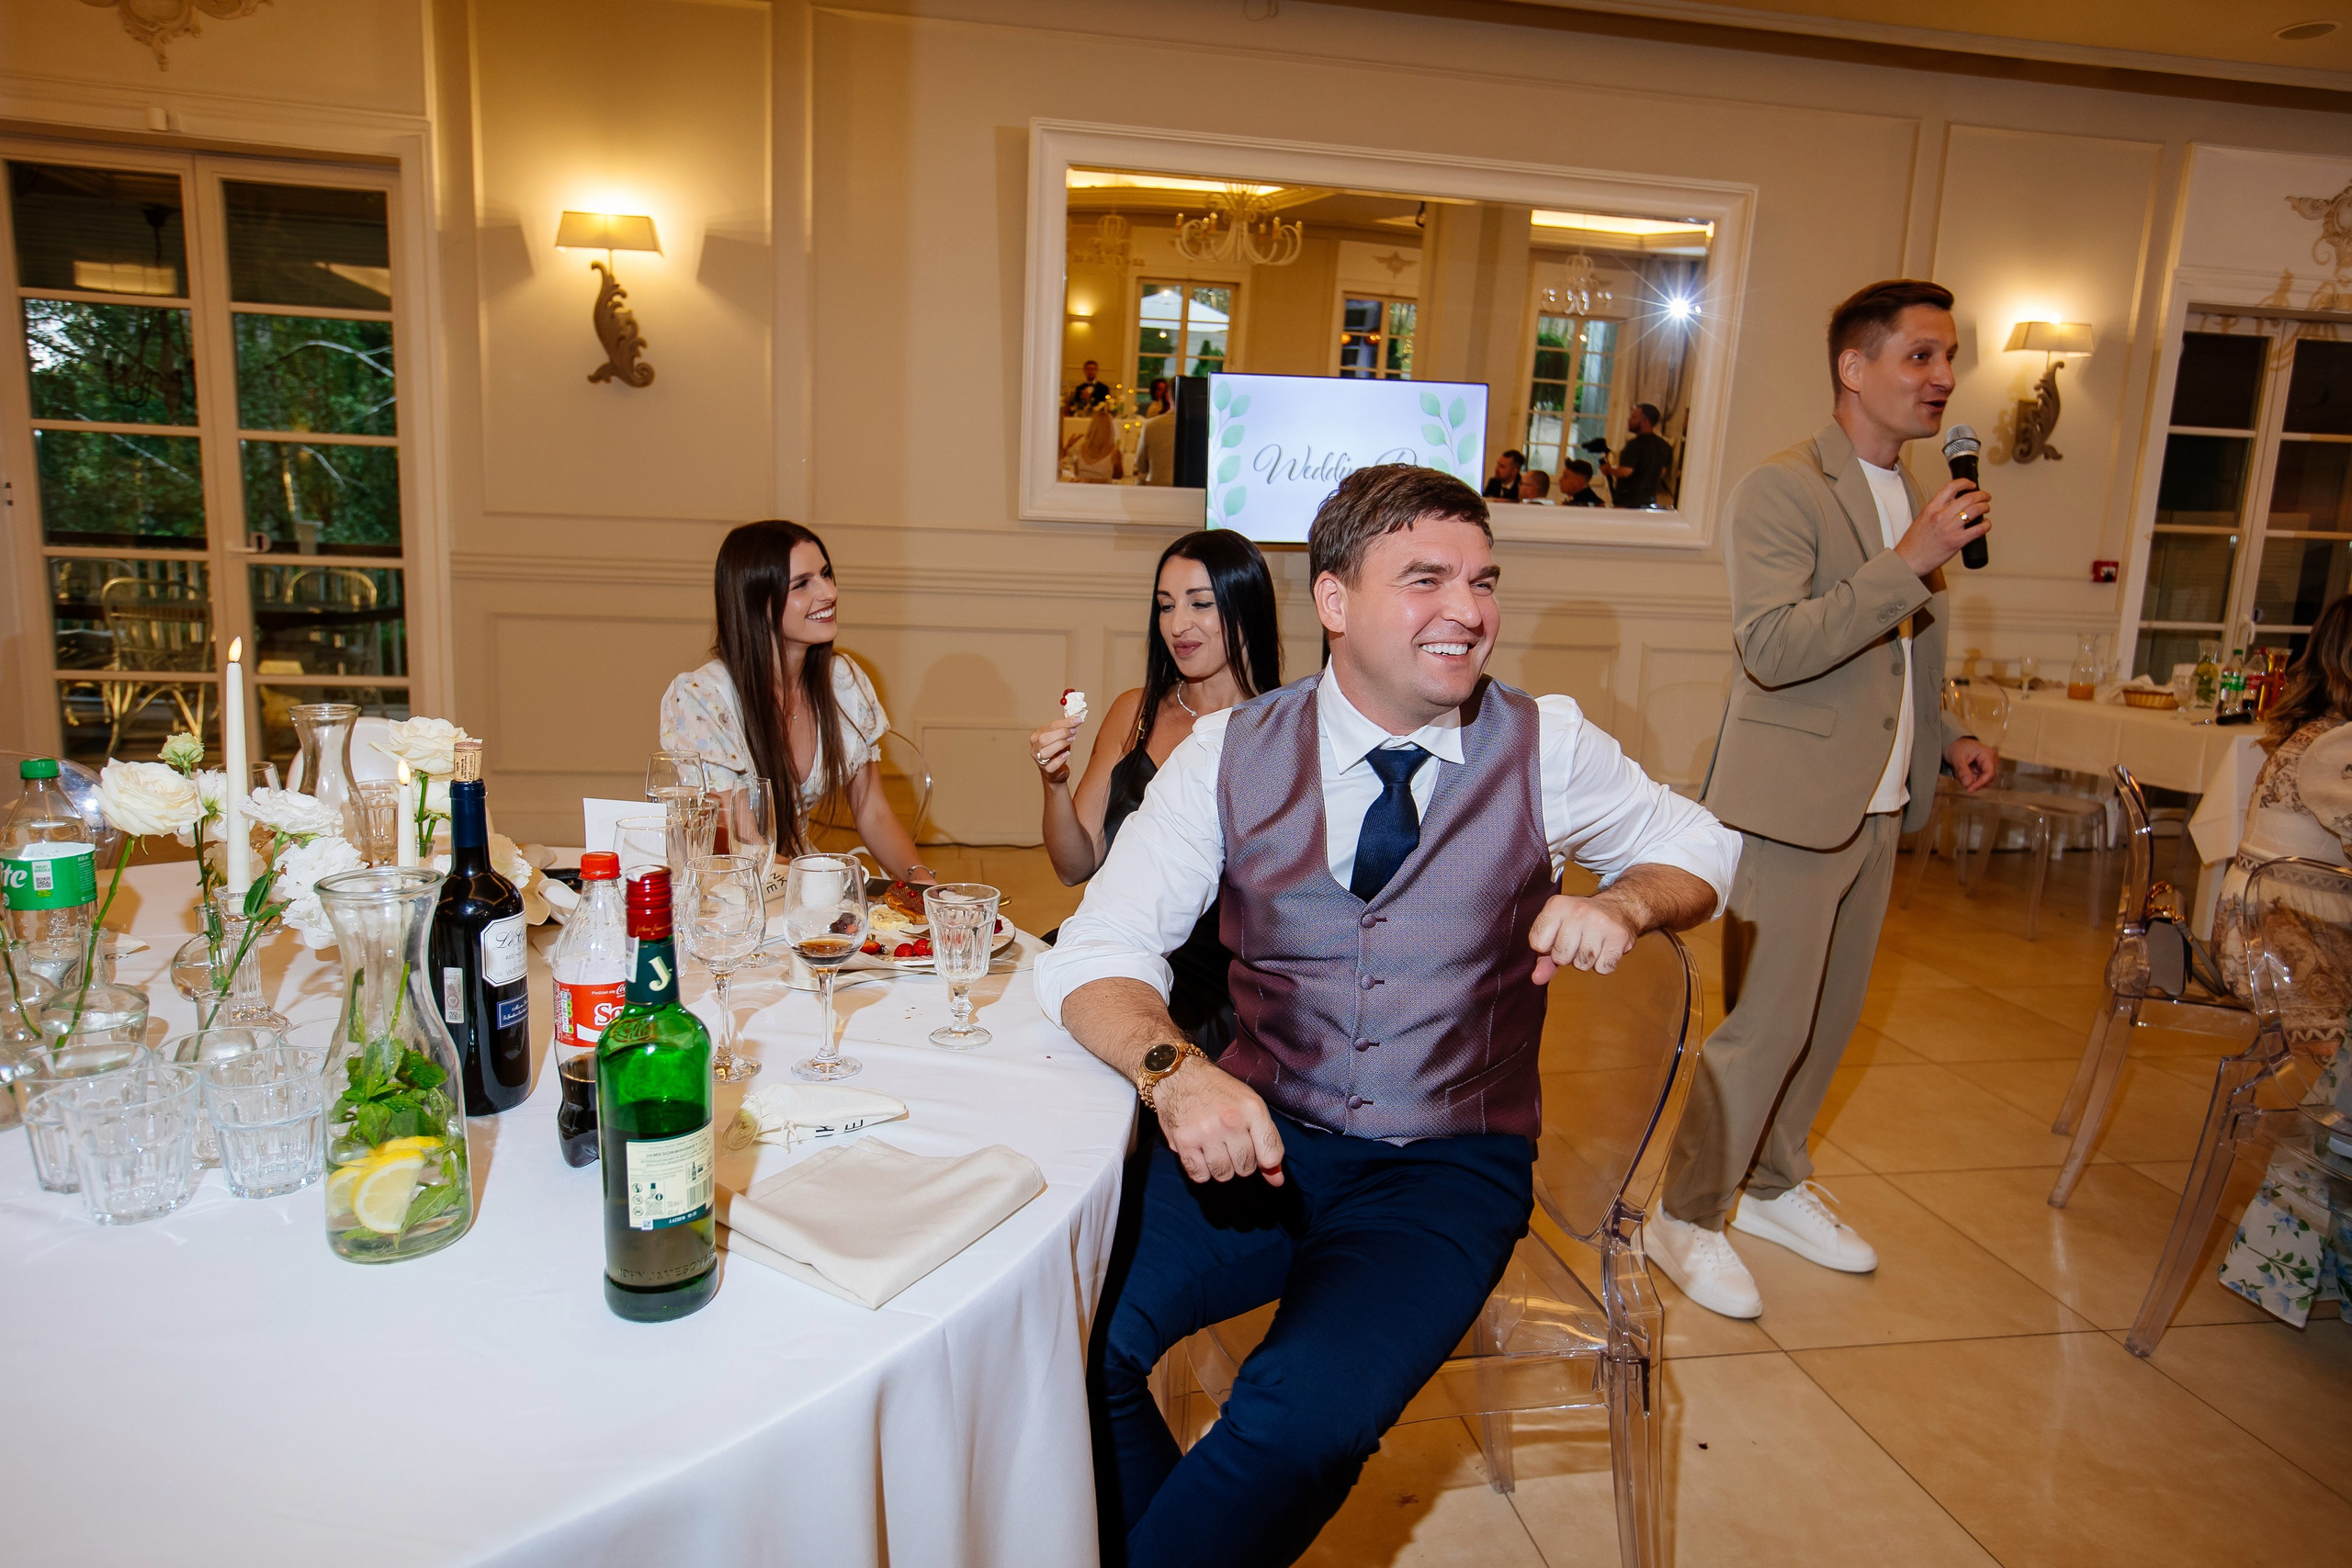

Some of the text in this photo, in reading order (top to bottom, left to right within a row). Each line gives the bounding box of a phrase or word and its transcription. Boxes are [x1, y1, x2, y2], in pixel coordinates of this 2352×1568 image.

[1253, 443, 1353, 485] Weddi
[770, 873, 787, 886] NK
[648, 956, 672, 991] J
[844, 1119, 864, 1131] E
